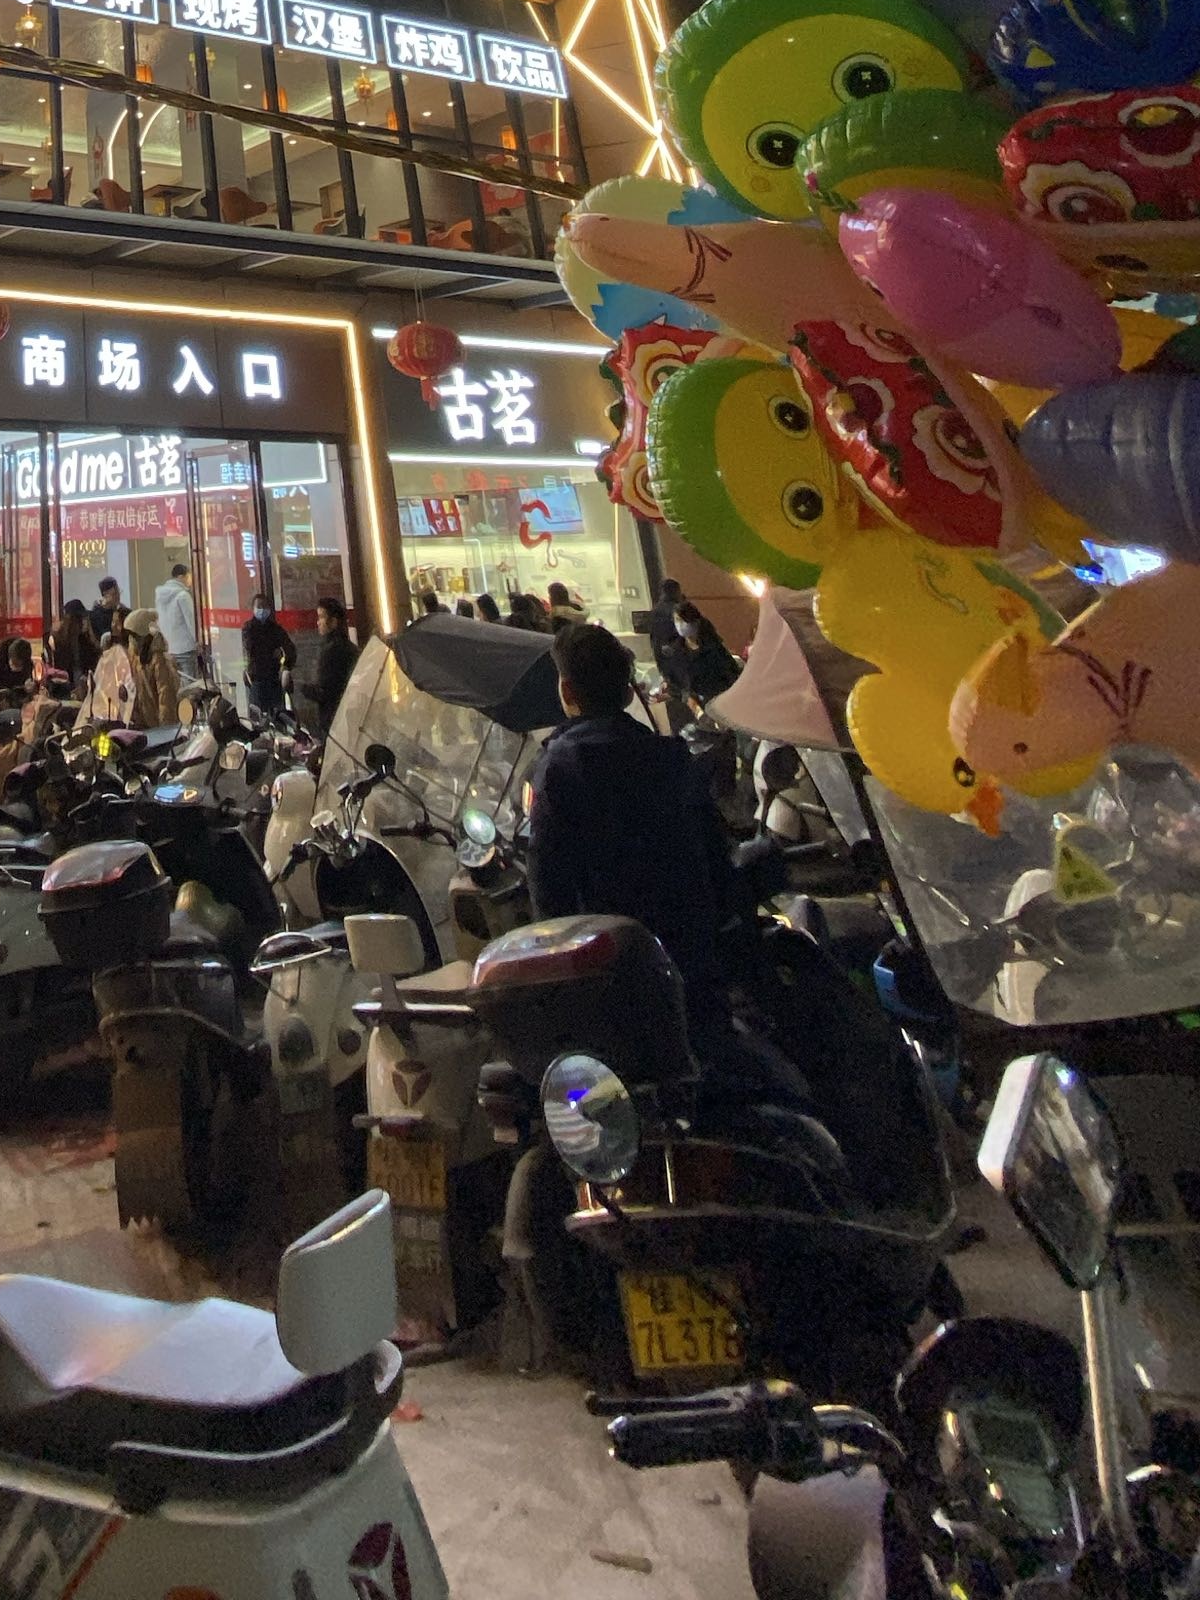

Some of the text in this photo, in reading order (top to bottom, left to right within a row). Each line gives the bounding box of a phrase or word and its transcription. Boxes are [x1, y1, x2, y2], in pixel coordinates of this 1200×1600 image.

[292, 3, 366, 57] 汉堡
[393, 27, 464, 74] 炸鸡
[489, 42, 557, 90] 饮品
[22, 335, 283, 400] 商场入口
[436, 369, 537, 446] 古茗
[135, 436, 184, 487] 古茗
